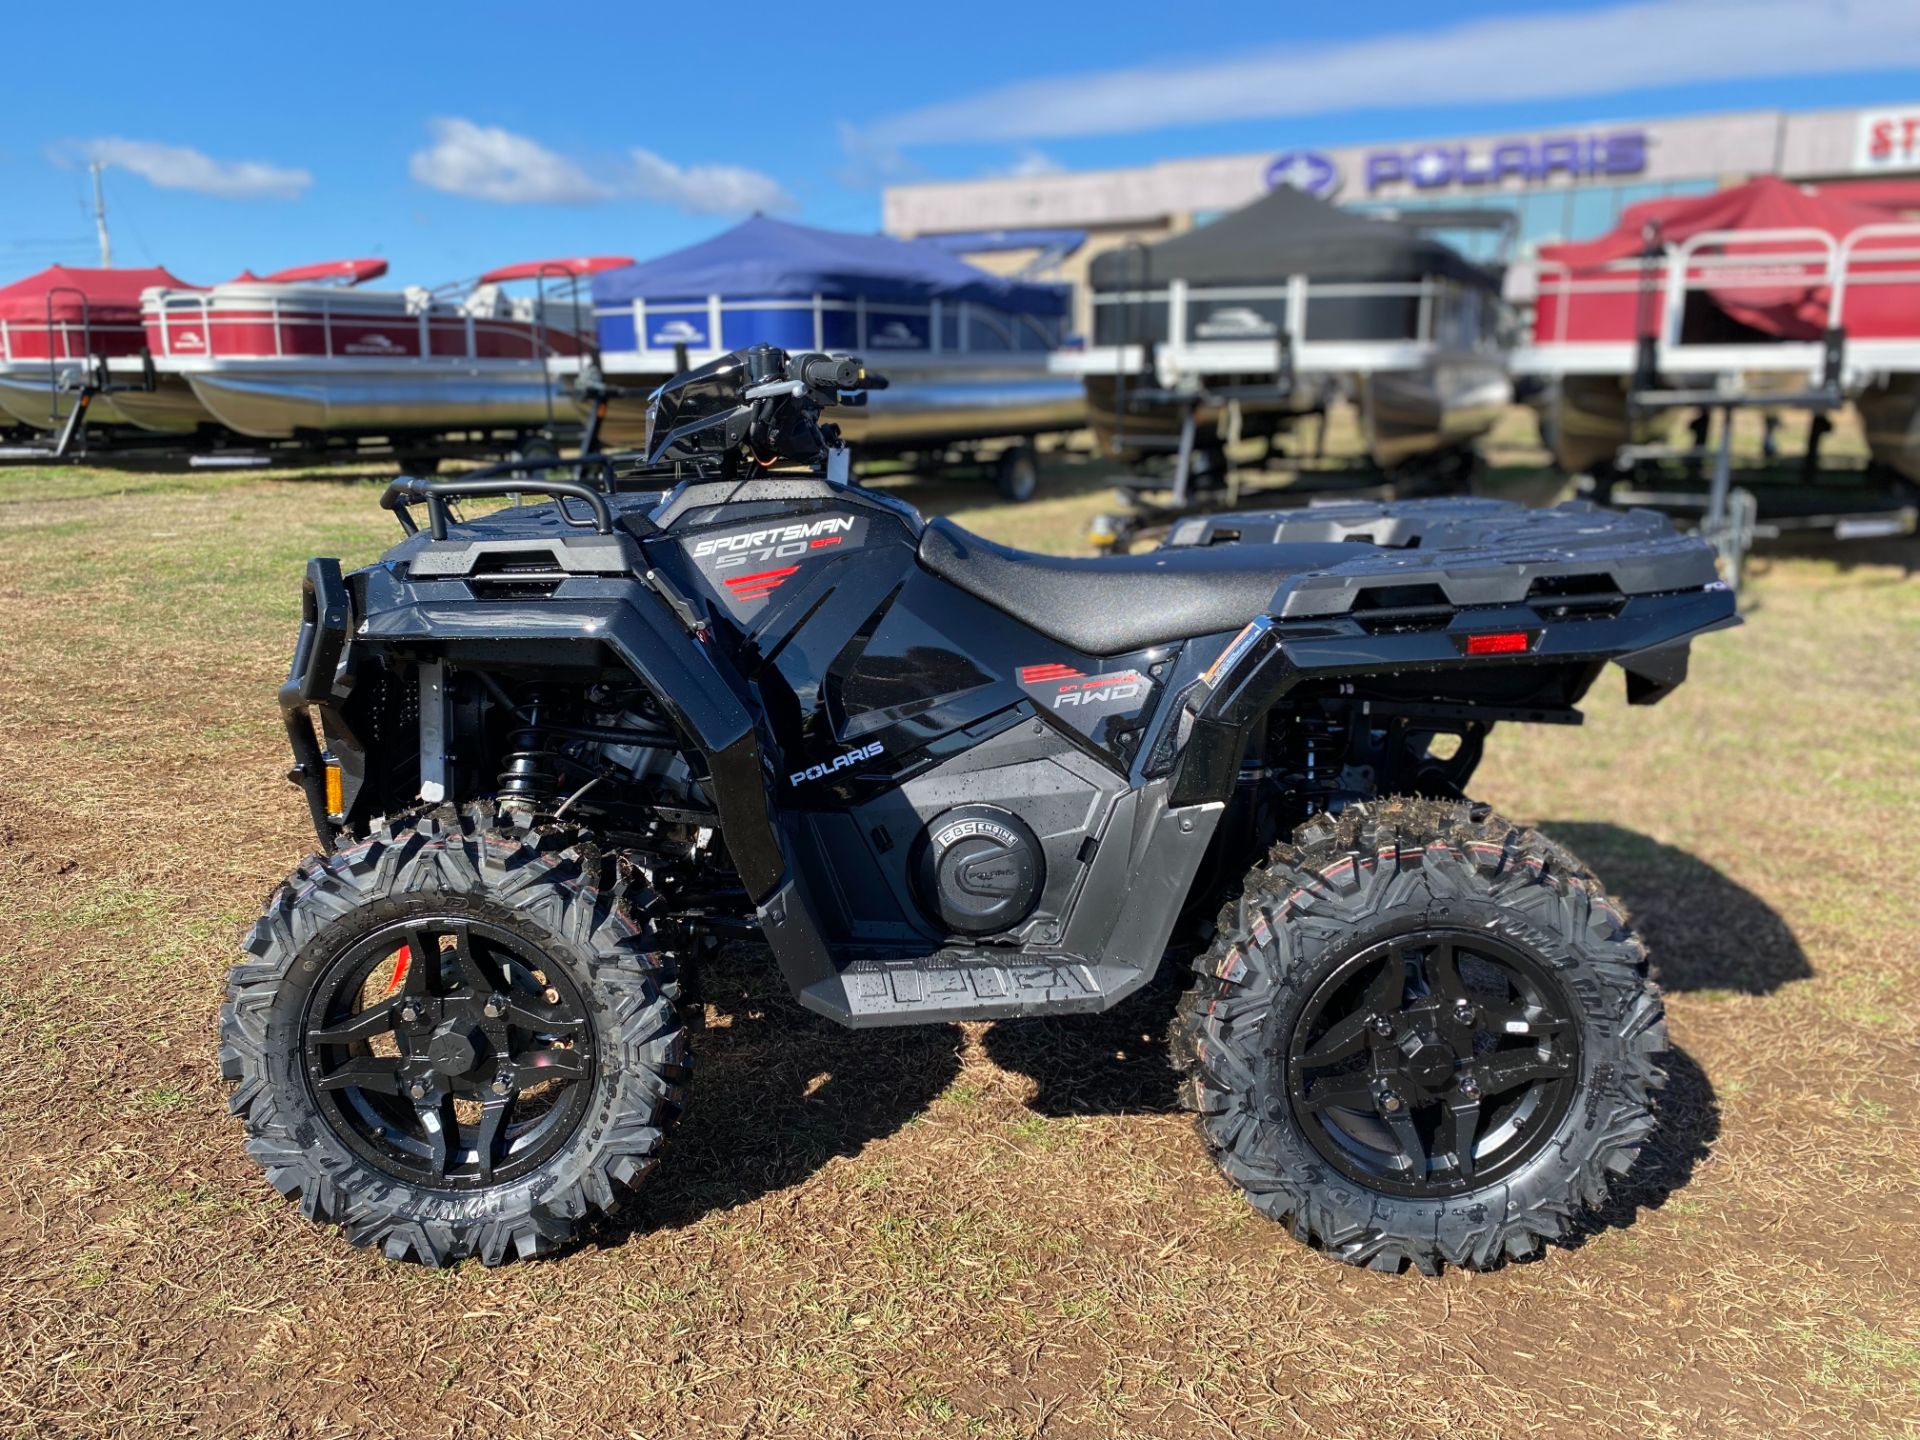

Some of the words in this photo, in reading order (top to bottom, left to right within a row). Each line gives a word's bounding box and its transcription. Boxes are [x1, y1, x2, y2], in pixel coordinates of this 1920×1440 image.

[1365, 130, 1646, 192] POLARIS
[692, 516, 855, 558] SPORTSMAN
[715, 541, 807, 569] 570
[1053, 684, 1139, 708] AWD
[789, 741, 884, 787] POLARIS
[976, 823, 1017, 844] ENGINE
